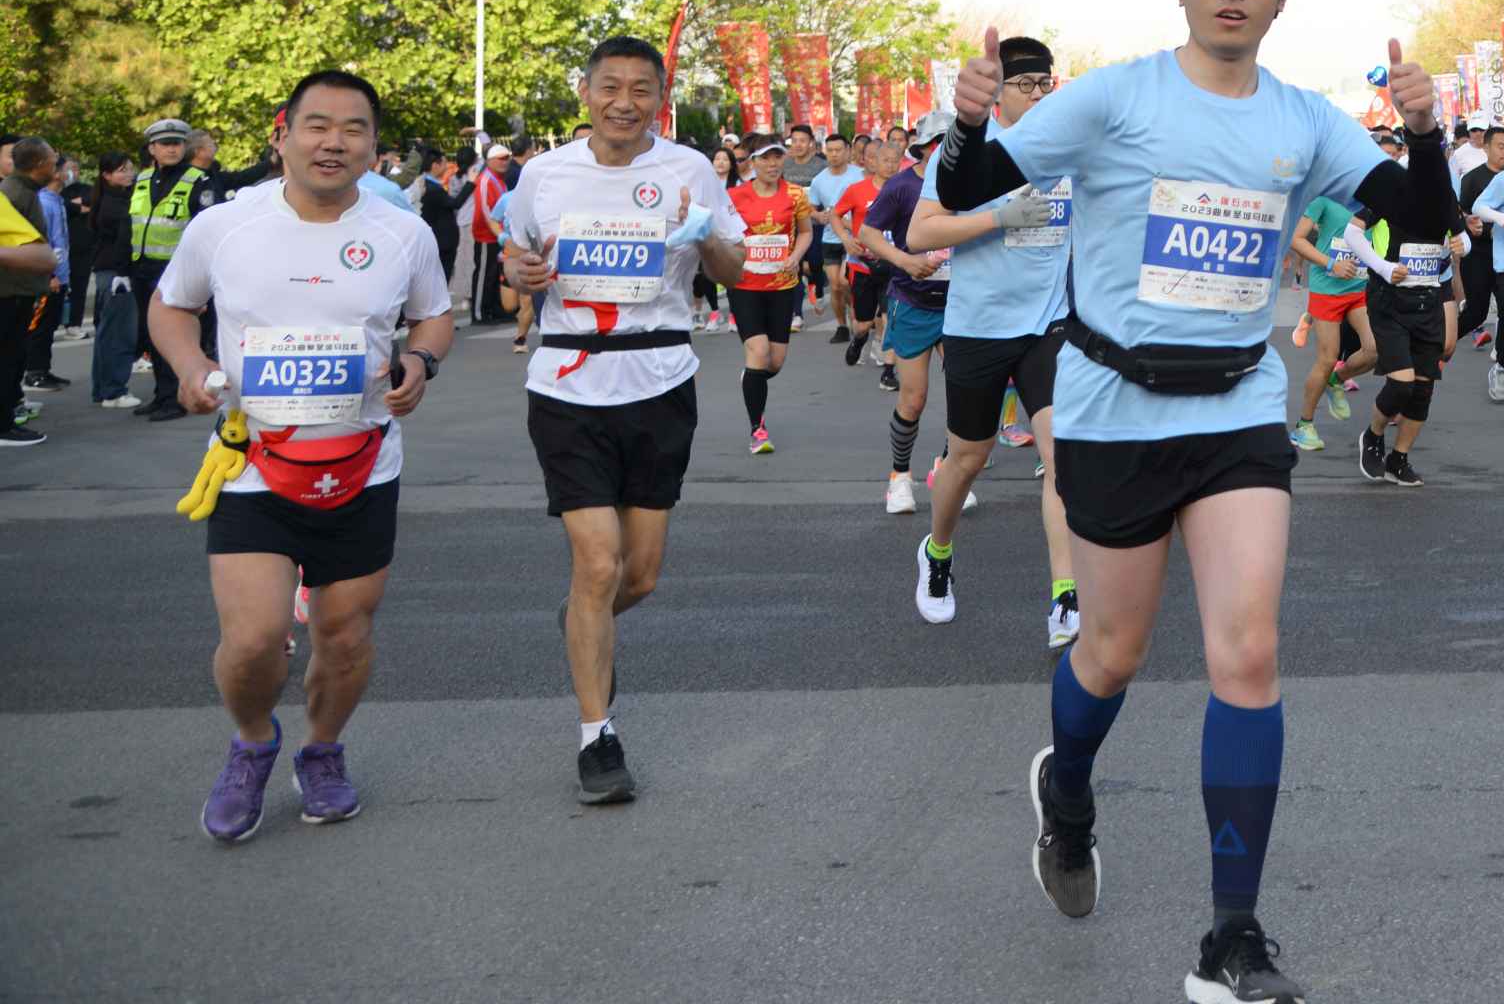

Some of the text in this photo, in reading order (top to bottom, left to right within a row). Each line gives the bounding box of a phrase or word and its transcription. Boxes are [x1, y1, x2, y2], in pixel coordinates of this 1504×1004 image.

[571, 243, 649, 268] A4079
[1162, 223, 1263, 265] A0422
[1407, 258, 1438, 271] A0420
[257, 359, 349, 386] A0325
